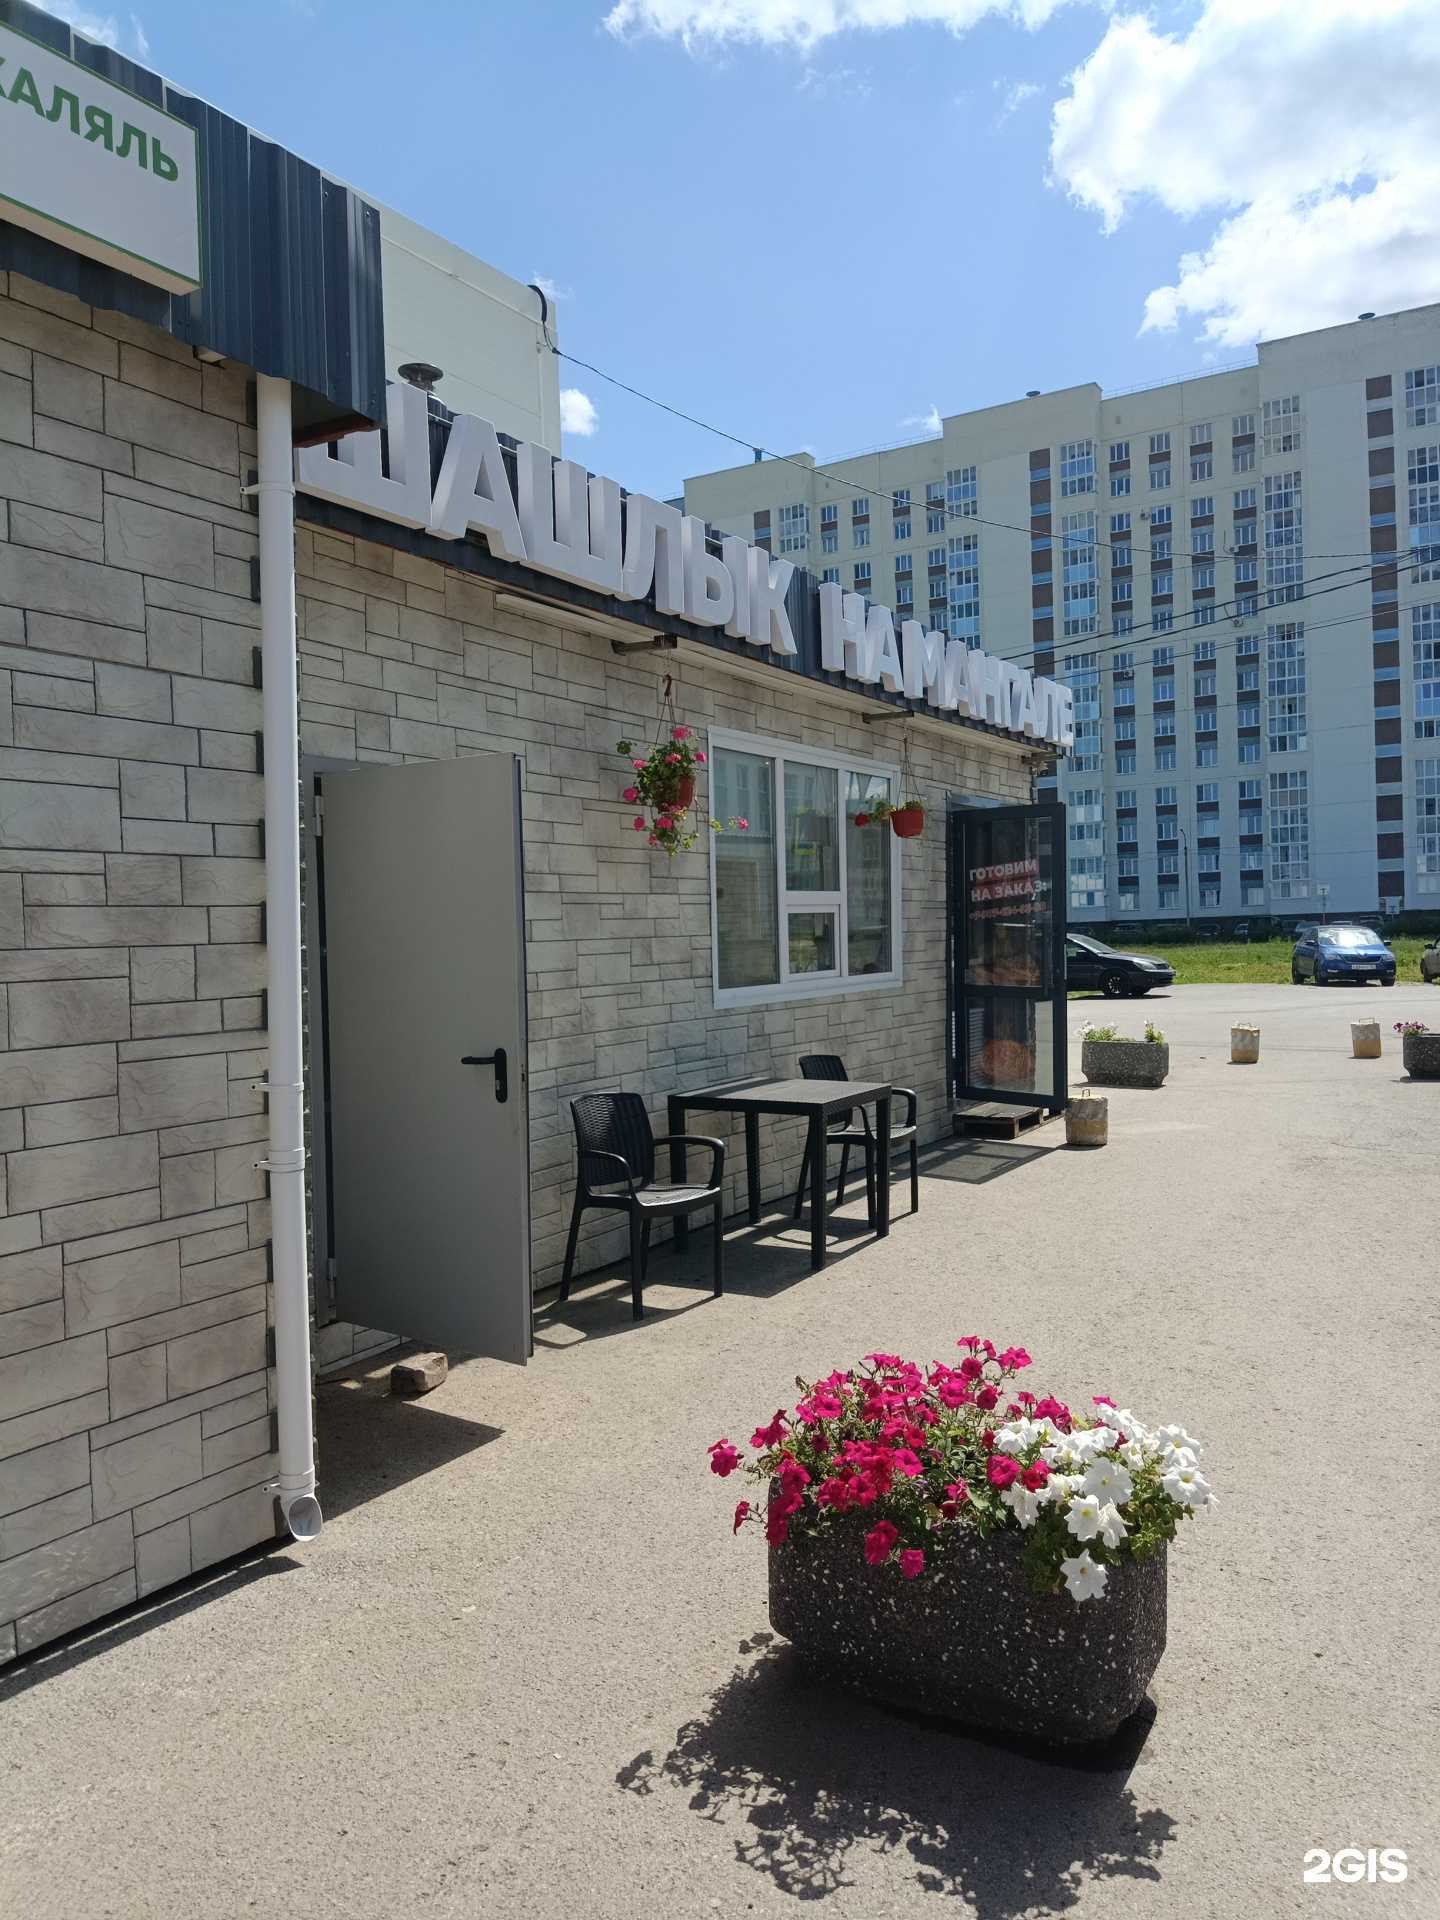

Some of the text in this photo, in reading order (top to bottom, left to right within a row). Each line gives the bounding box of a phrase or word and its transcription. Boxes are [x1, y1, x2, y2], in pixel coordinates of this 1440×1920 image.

[0, 57, 179, 182] АЛЯЛЬ
[296, 381, 797, 656] ШАШЛЫК
[969, 859, 1037, 881] ГОТОВИМ
[971, 888, 991, 902] НА
